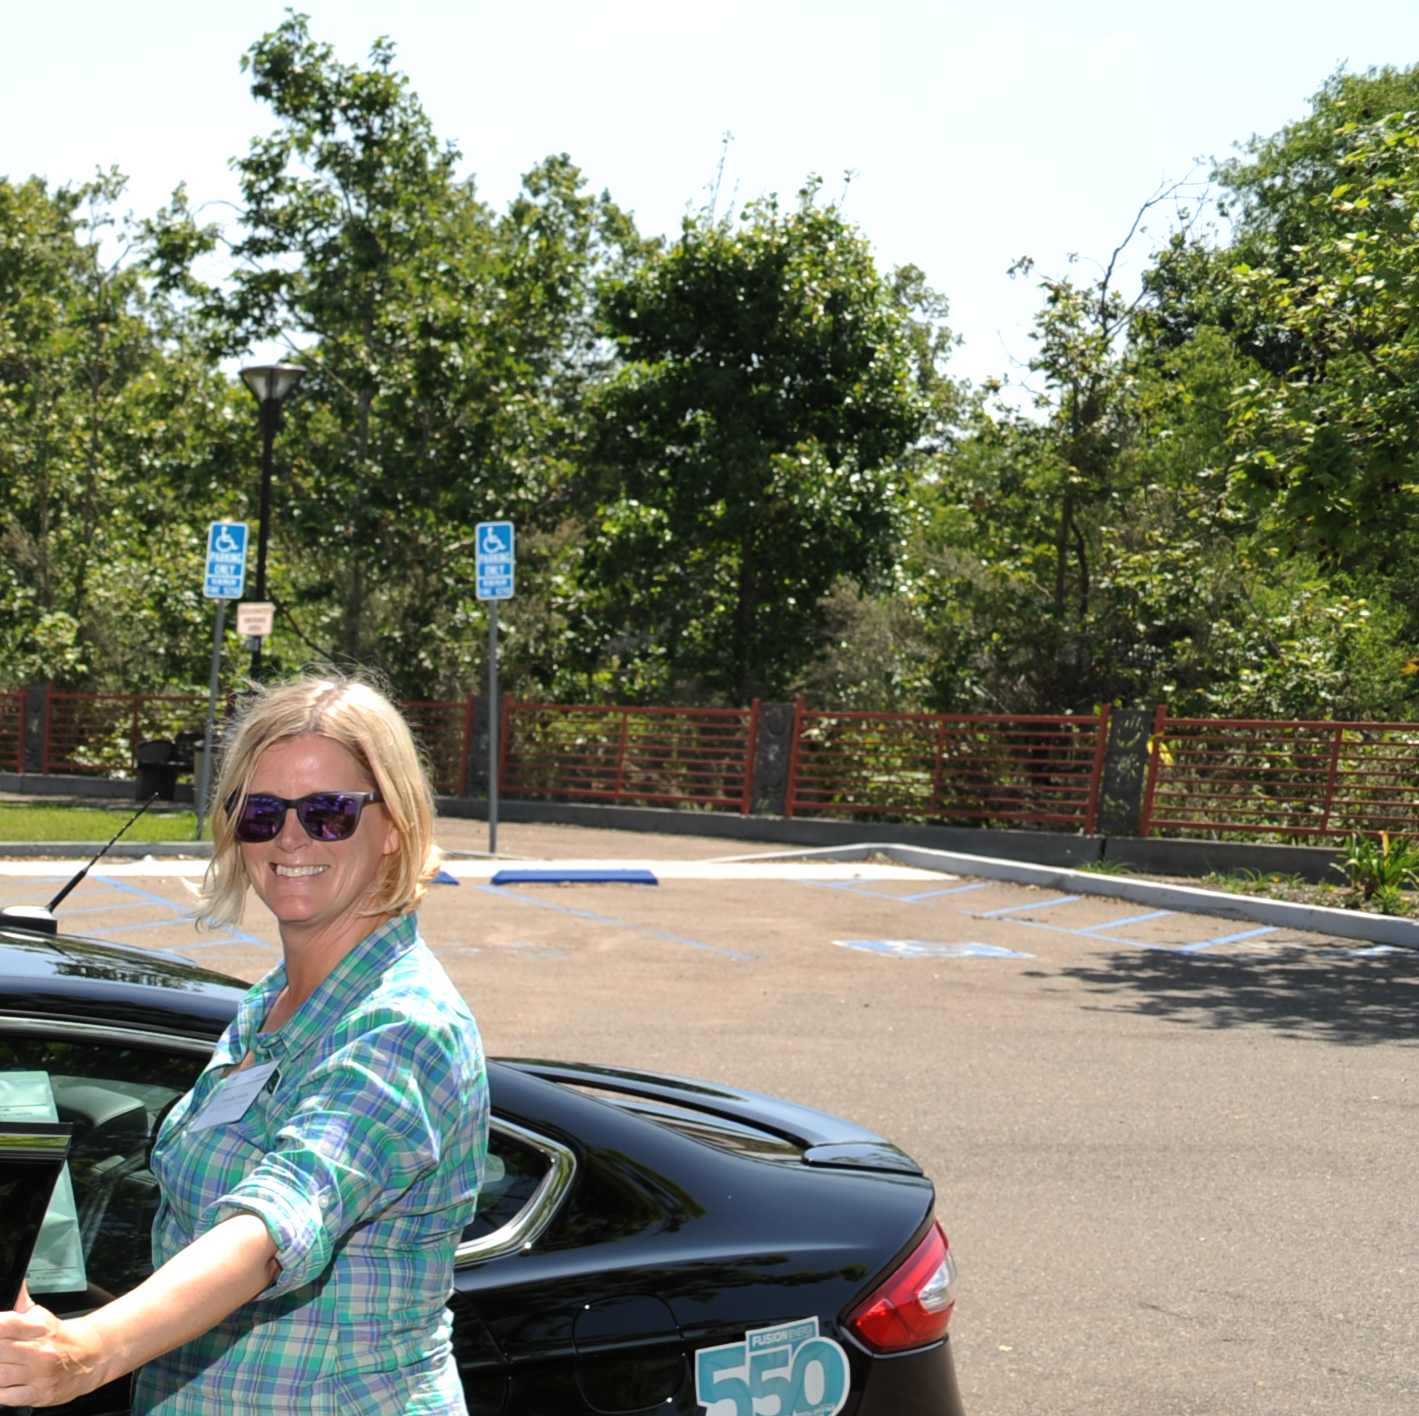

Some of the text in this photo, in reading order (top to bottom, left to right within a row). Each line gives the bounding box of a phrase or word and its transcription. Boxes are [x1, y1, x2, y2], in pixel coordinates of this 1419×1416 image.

[210, 551, 243, 564] PARKING
[479, 552, 511, 564] PARKING
[214, 563, 236, 575] ONLY
[485, 565, 505, 576] ONLY
[751, 1325, 813, 1347] FUSION ENERGI
